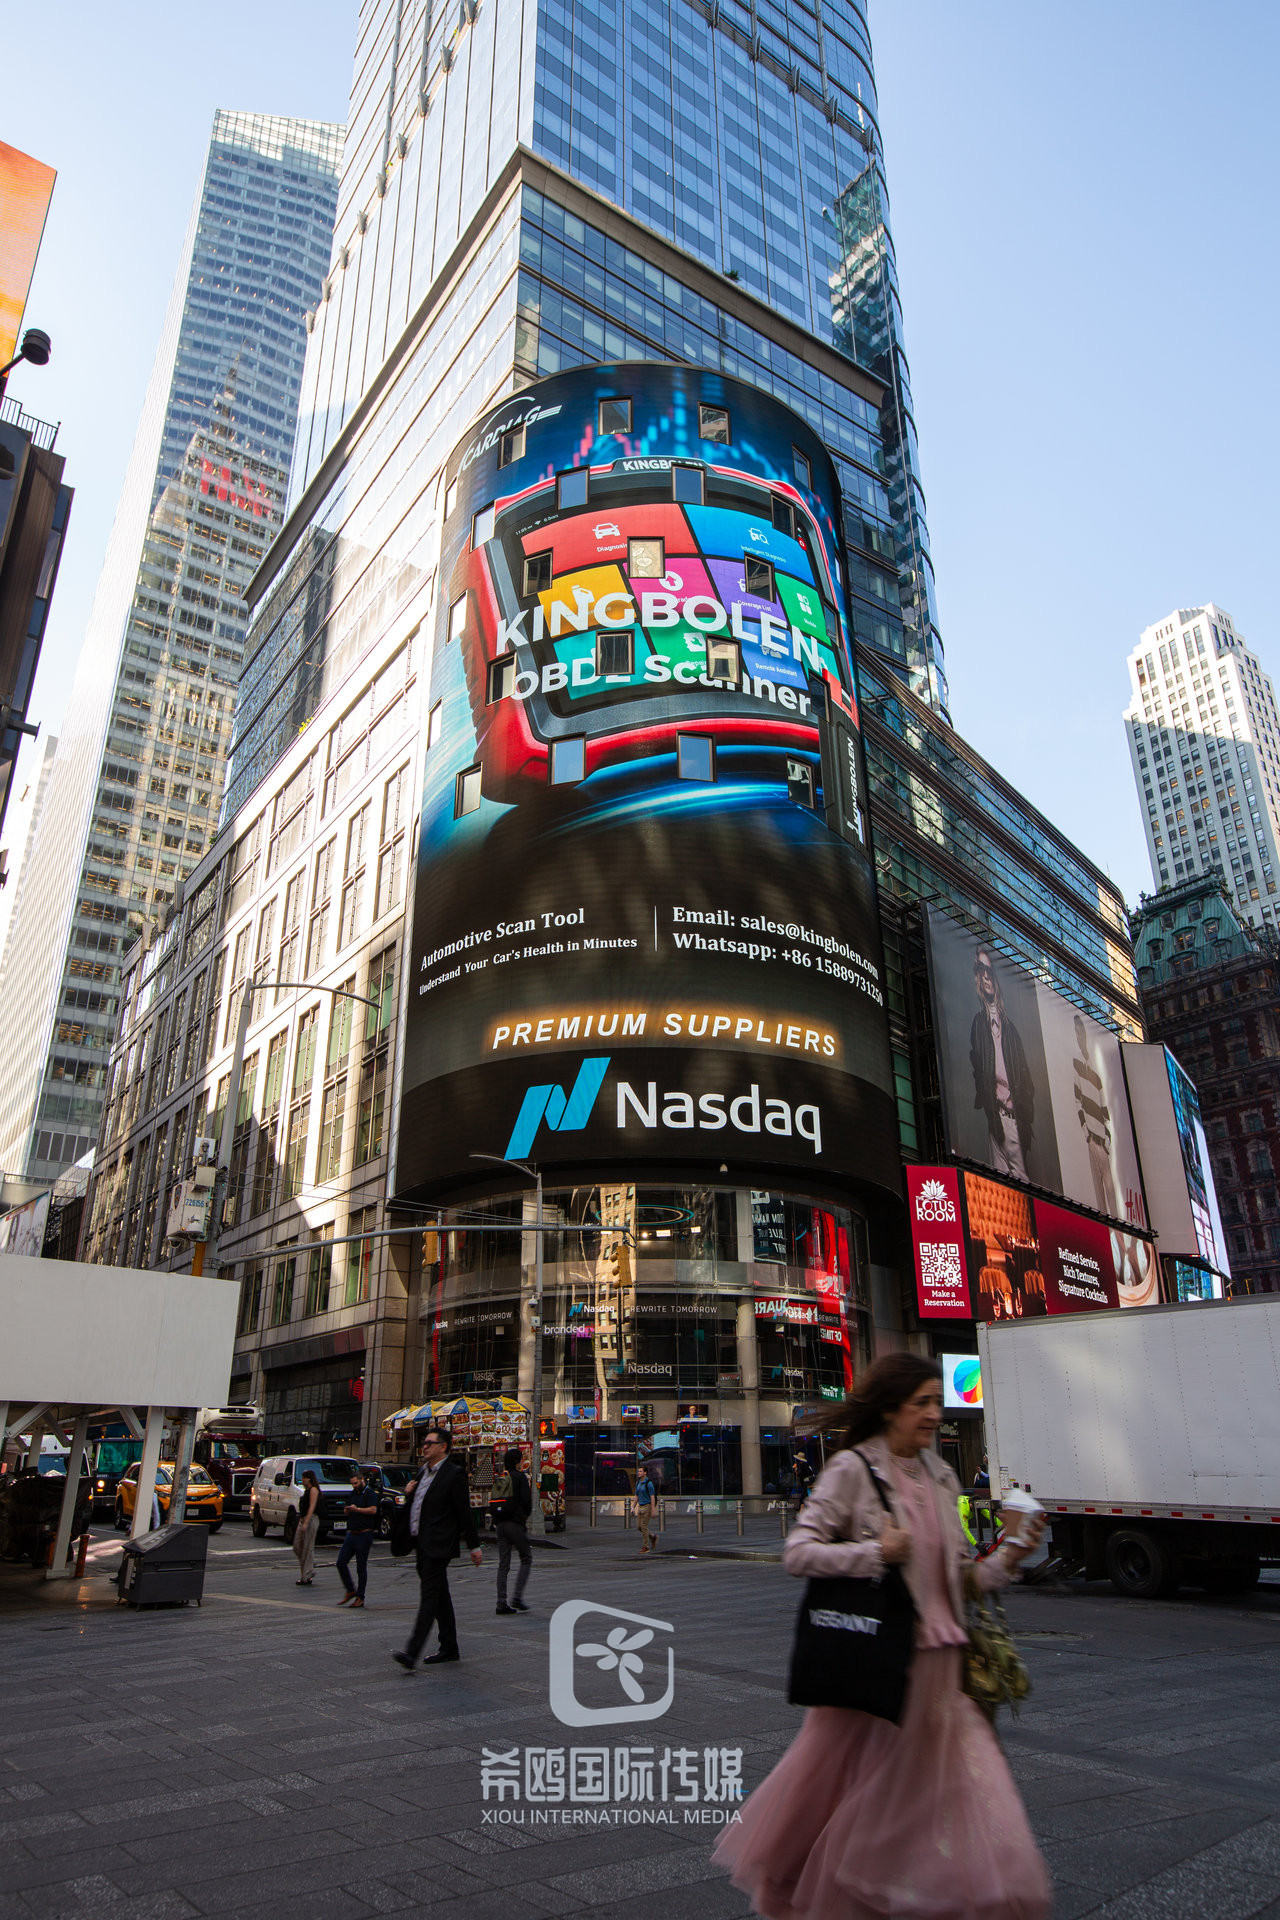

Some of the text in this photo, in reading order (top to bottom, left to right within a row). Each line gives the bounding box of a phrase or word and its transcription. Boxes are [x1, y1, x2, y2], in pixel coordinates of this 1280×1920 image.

[622, 459, 703, 471] KINGB
[596, 543, 628, 552] Diagnosi
[737, 600, 762, 610] Coverage
[496, 592, 819, 672] KINGBOLEN
[510, 655, 631, 700] OBD
[420, 908, 585, 971] Automotive Scan Tool
[672, 906, 879, 981] Email: sales@kingbolen.com
[672, 932, 777, 962] Whatsapp:
[781, 949, 812, 968] +86
[419, 937, 638, 995] Understand Your Car's Health in Minutes
[492, 1013, 836, 1056] PREMIUM SUPPLIERS
[616, 1081, 823, 1155] Nasdaq
[915, 1200, 955, 1213] LOTUS
[916, 1209, 956, 1222] ROOM
[1058, 1247, 1080, 1264] Refined
[1062, 1264, 1076, 1279] Rich
[931, 1290, 950, 1298] Make
[1058, 1279, 1109, 1304] Signature Cocktails
[583, 1304, 718, 1314] Nasdaq REWRITE TOMORROW
[924, 1299, 965, 1307] Reservation
[478, 1311, 513, 1322] TOMORROW
[544, 1324, 585, 1334] branded
[628, 1362, 673, 1377] Nasdaq
[783, 1368, 804, 1379] Nasdaq
